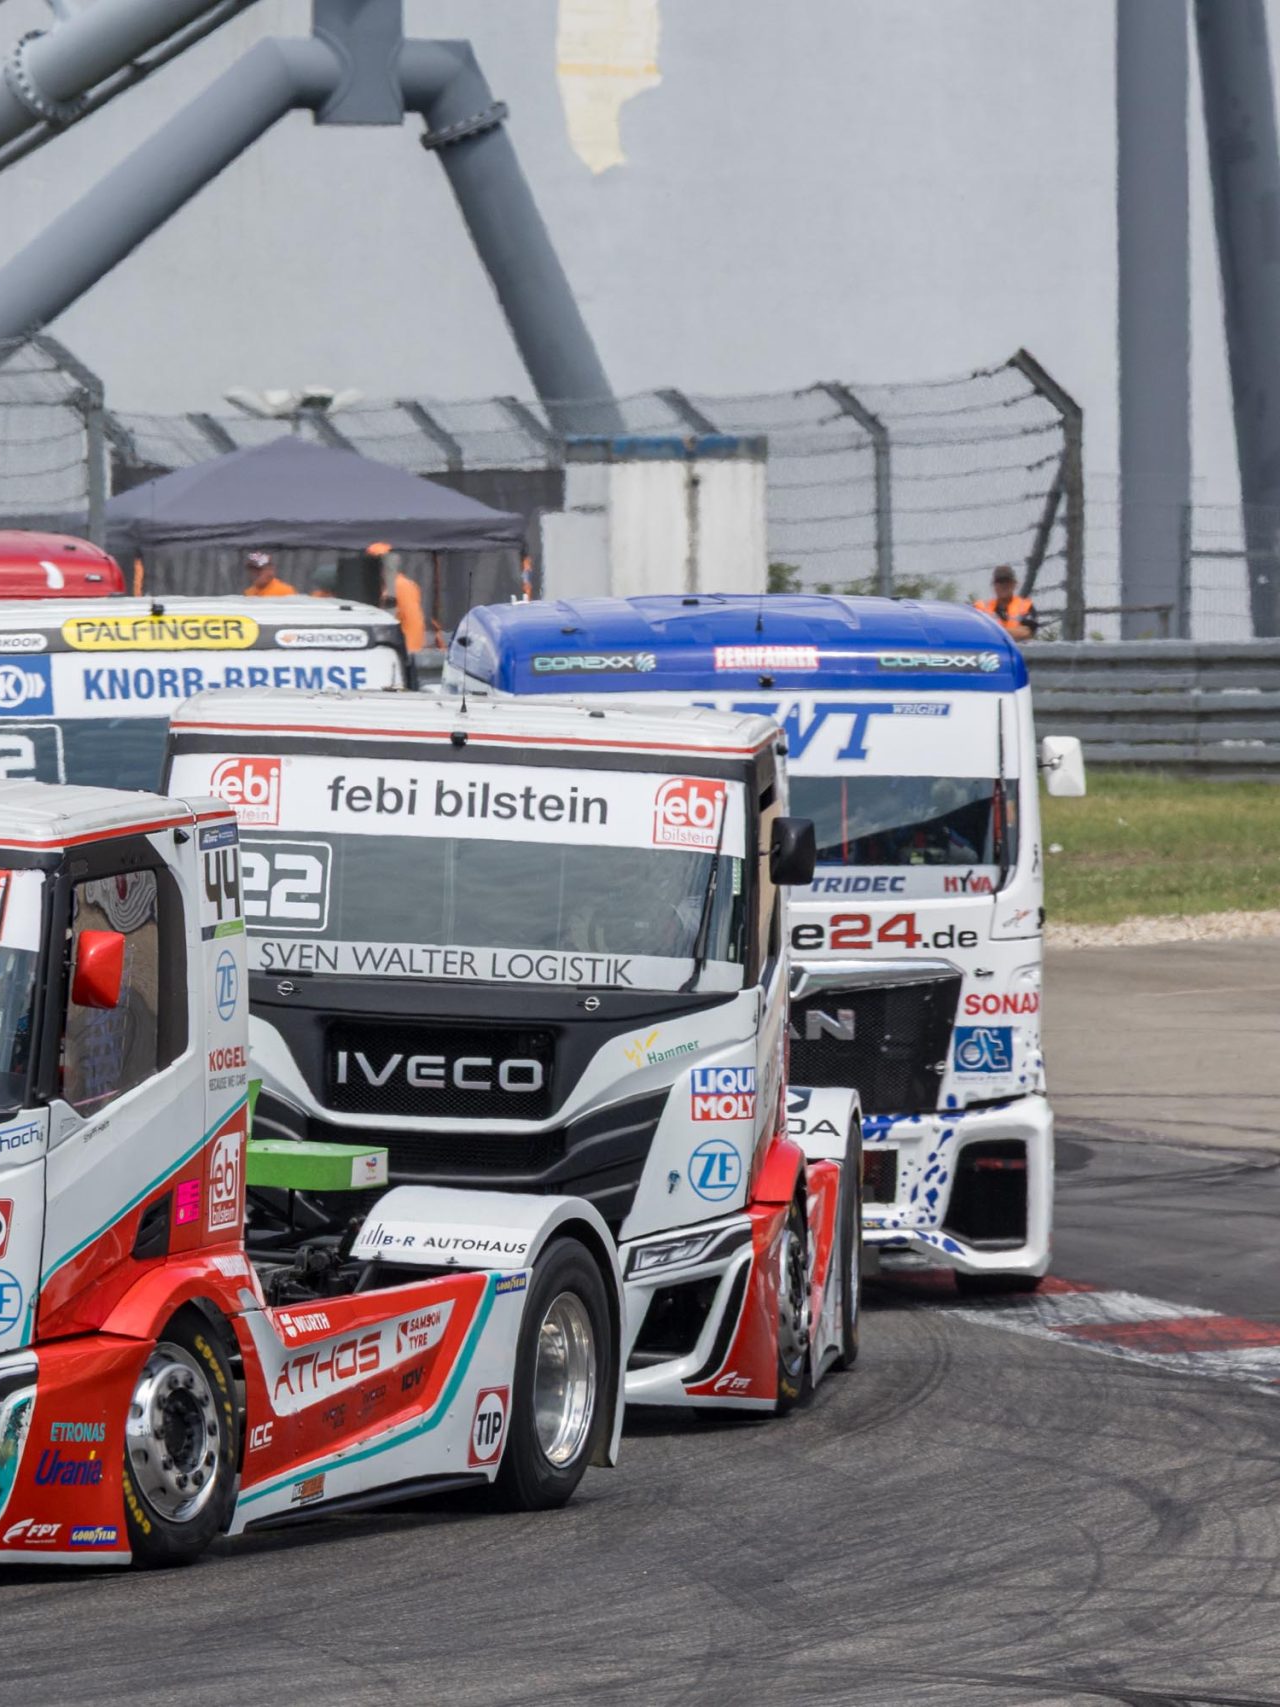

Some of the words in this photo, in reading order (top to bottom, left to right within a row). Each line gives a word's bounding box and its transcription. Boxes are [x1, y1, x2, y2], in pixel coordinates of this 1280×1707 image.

[76, 618, 245, 643] PALFINGER
[534, 656, 633, 671] COREXX
[880, 652, 977, 667] COREXX
[84, 666, 367, 700] KNORR-BREMSE
[892, 704, 947, 716] WRIGHT
[327, 775, 418, 816] febi
[436, 779, 609, 825] bilstein
[655, 779, 724, 829] febi
[662, 826, 714, 845] bilstein
[205, 848, 240, 920] 44
[811, 876, 906, 893] TRIDEC
[944, 869, 994, 893] HYVA
[791, 913, 978, 950] e24.de
[260, 942, 338, 972] SVEN
[353, 946, 478, 977] WALTER
[492, 953, 632, 985] LOGISTIK
[646, 1040, 700, 1065] Hammer
[337, 1050, 544, 1093] IVECO
[694, 1068, 756, 1095] LIQUI
[694, 1096, 756, 1120] MOLY
[423, 1237, 528, 1254] AUTOHAUS
[409, 1310, 441, 1332] SAMSON
[409, 1332, 428, 1350] TYRE
[274, 1330, 382, 1401] ATHOS
[50, 1422, 106, 1442] ETRONAS
[249, 1421, 273, 1449] ICC
[477, 1411, 502, 1446] TIP
[34, 1449, 103, 1486] Urania
[26, 1523, 62, 1537] FPT
[72, 1526, 117, 1544] GOODYEAR
